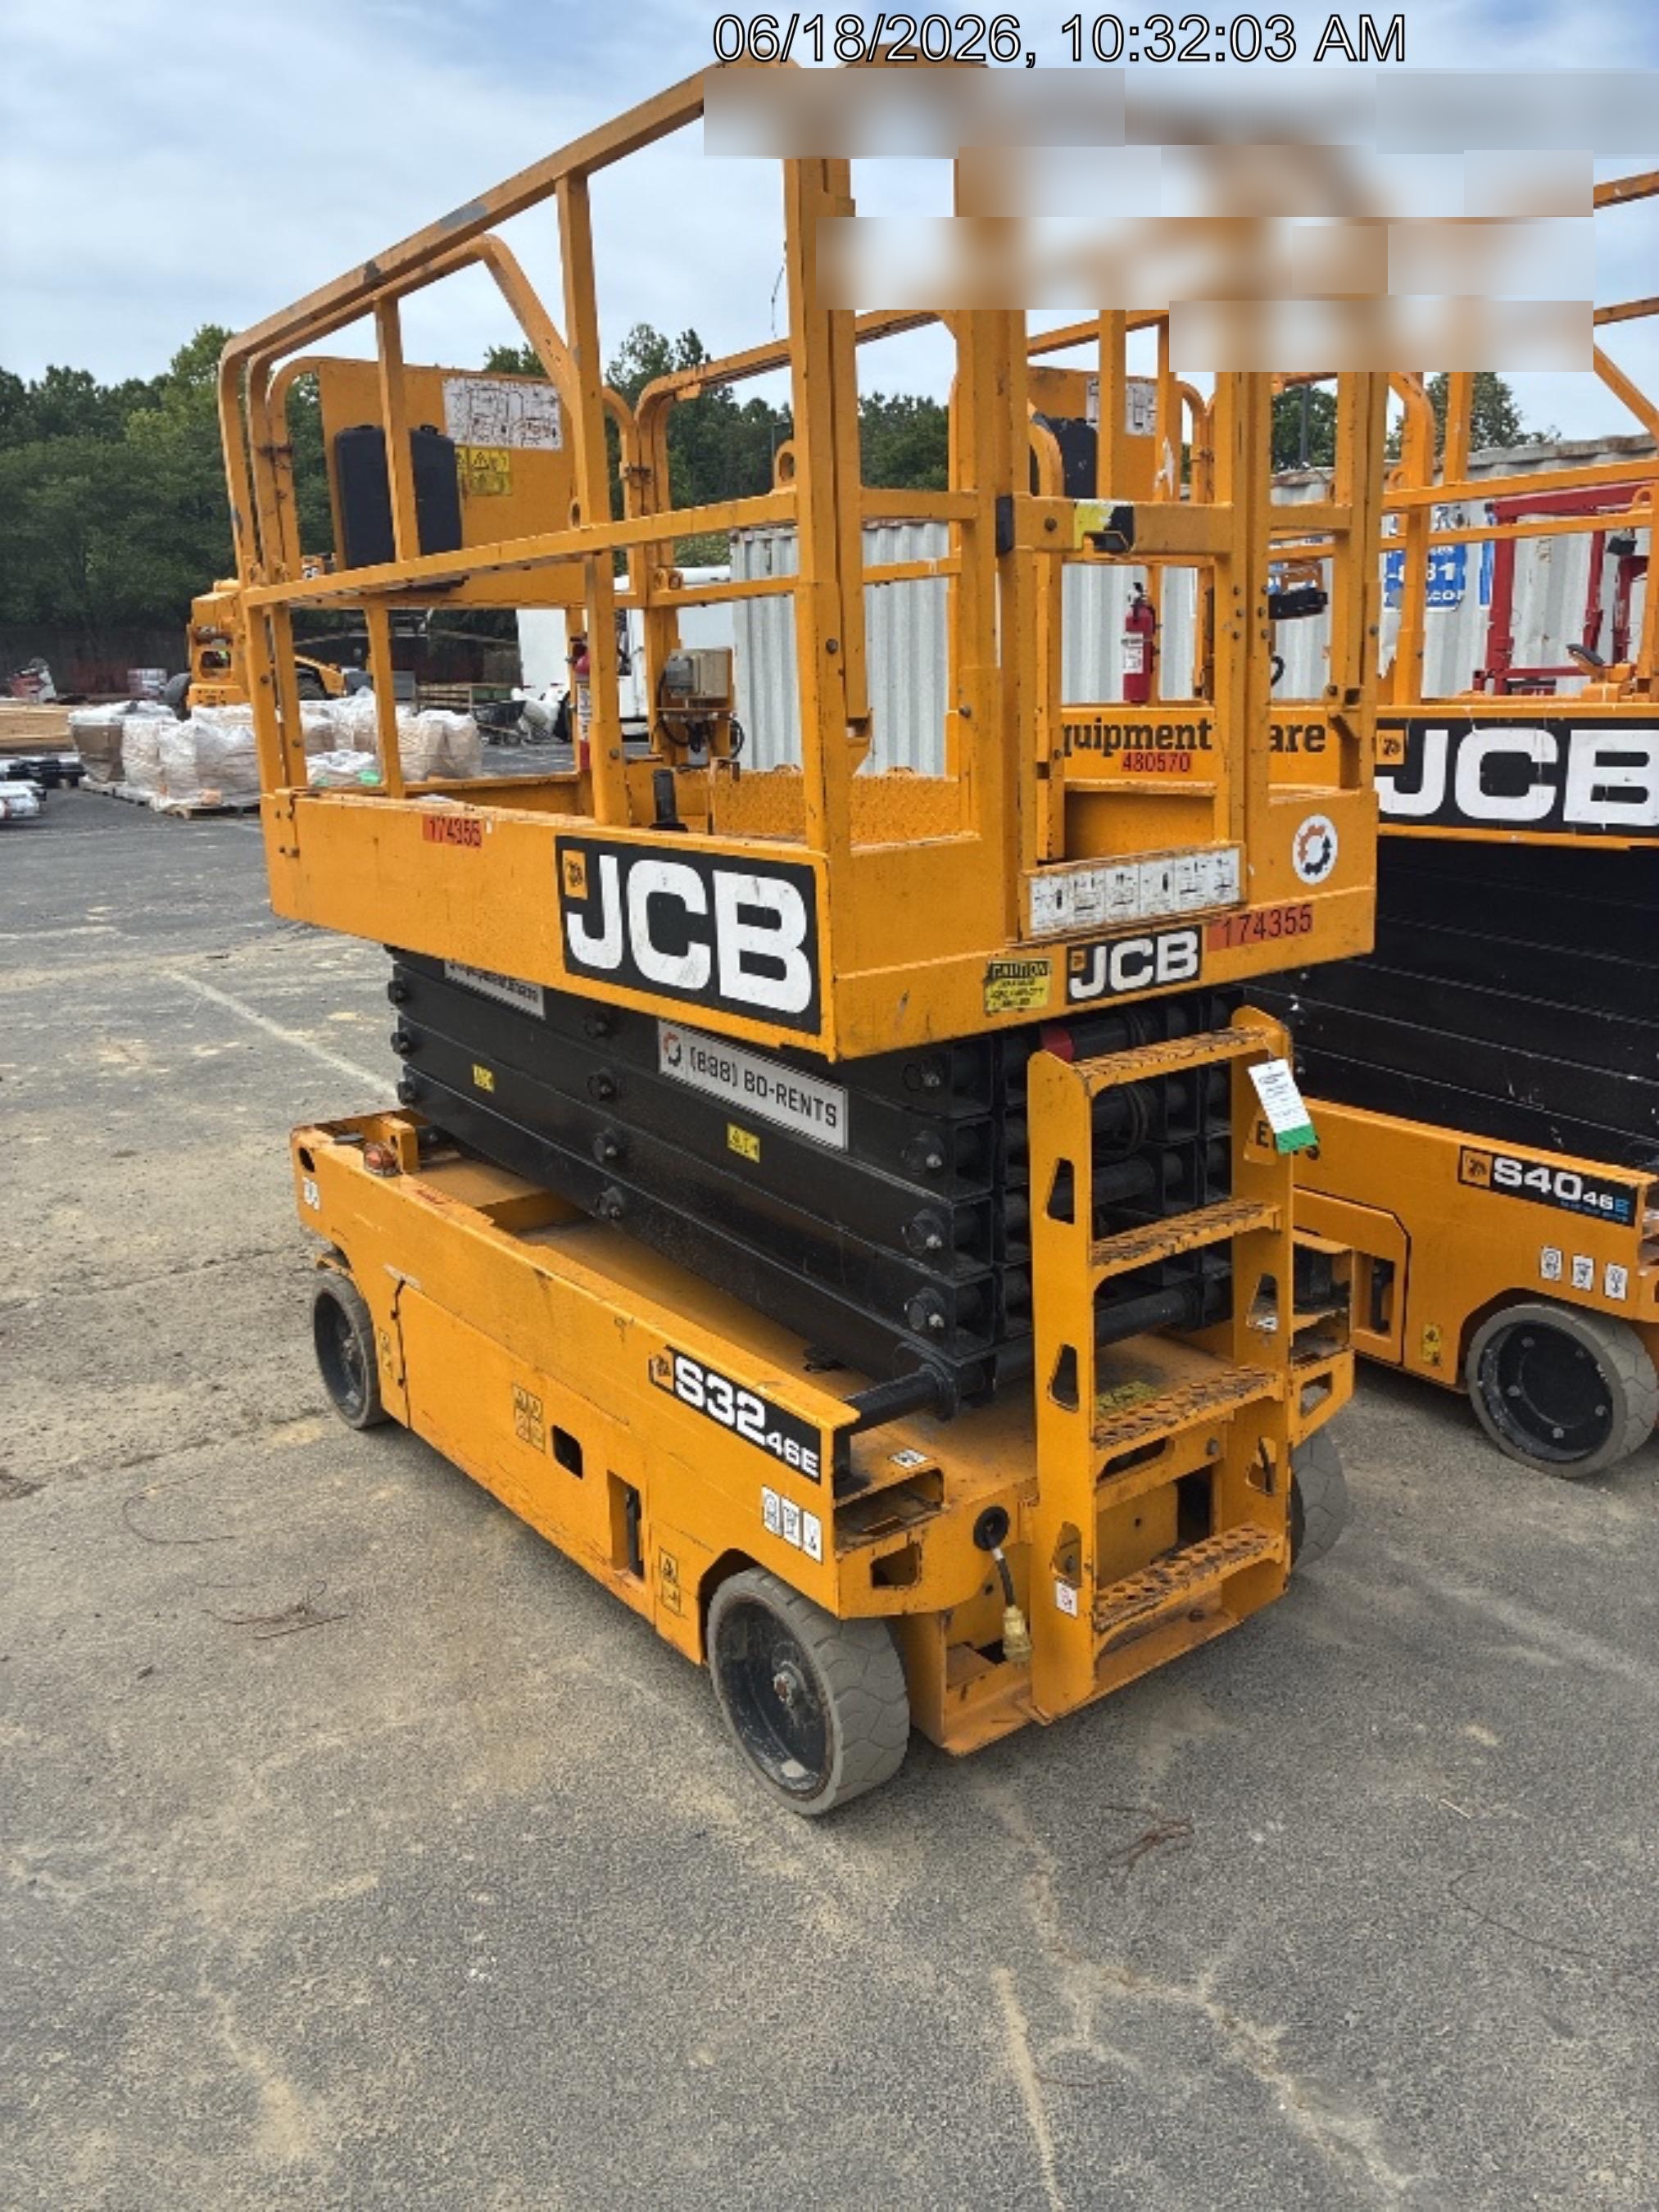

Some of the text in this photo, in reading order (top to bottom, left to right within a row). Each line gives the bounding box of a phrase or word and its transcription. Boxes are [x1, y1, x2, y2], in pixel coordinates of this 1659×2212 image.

[1122, 752, 1191, 773] 480570
[1374, 727, 1659, 827] JCB
[567, 854, 812, 1014] JCB
[1222, 904, 1312, 948] 174355
[1069, 931, 1199, 999] JCB
